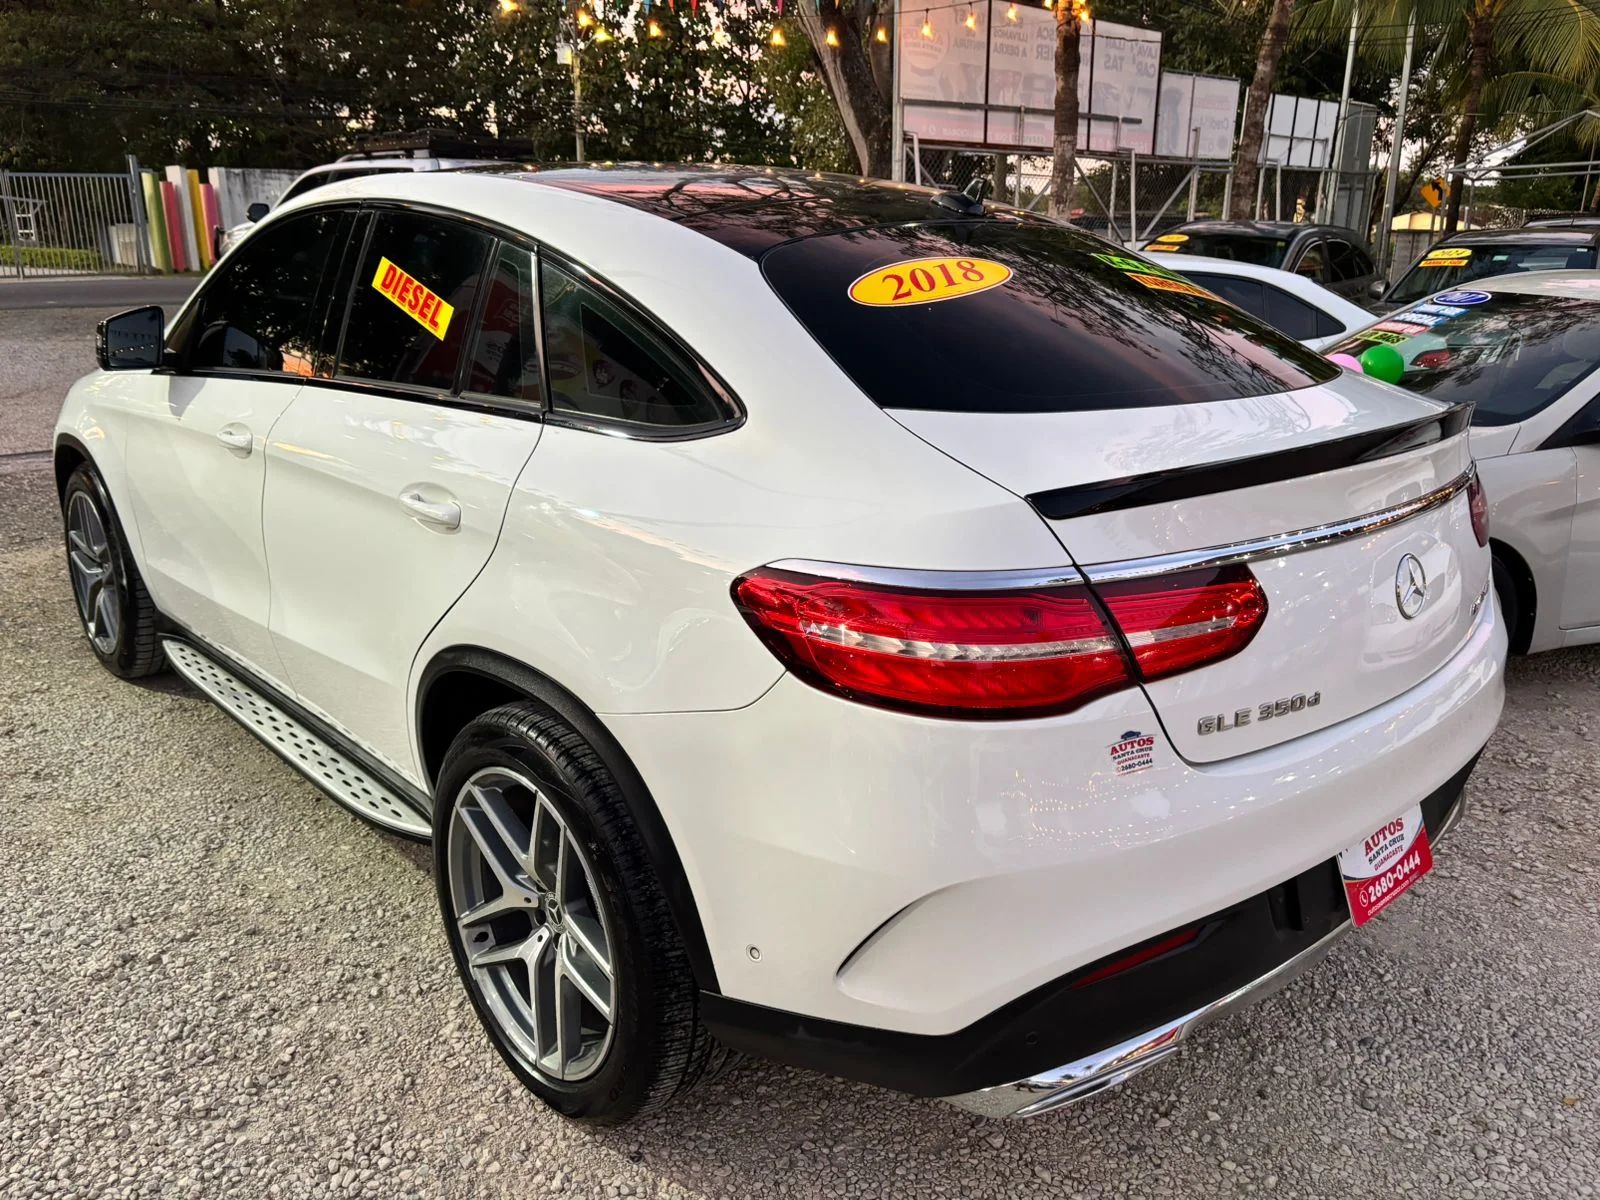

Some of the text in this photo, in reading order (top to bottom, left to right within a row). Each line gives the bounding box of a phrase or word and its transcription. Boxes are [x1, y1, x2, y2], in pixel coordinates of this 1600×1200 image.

[882, 260, 985, 301] 2018
[380, 264, 443, 332] DIESEL
[1197, 690, 1321, 736] GLE 350d
[1110, 736, 1154, 756] AUTOS
[1112, 746, 1153, 760] SANTA CRUZ
[1116, 753, 1150, 765] GUANACASTE
[1120, 758, 1153, 771] 2680-0444
[1364, 817, 1404, 856] AUTOS
[1368, 833, 1405, 865] SANTA CRUZ
[1373, 845, 1404, 871] GUANACASTE
[1368, 850, 1421, 903] 2680-0444
